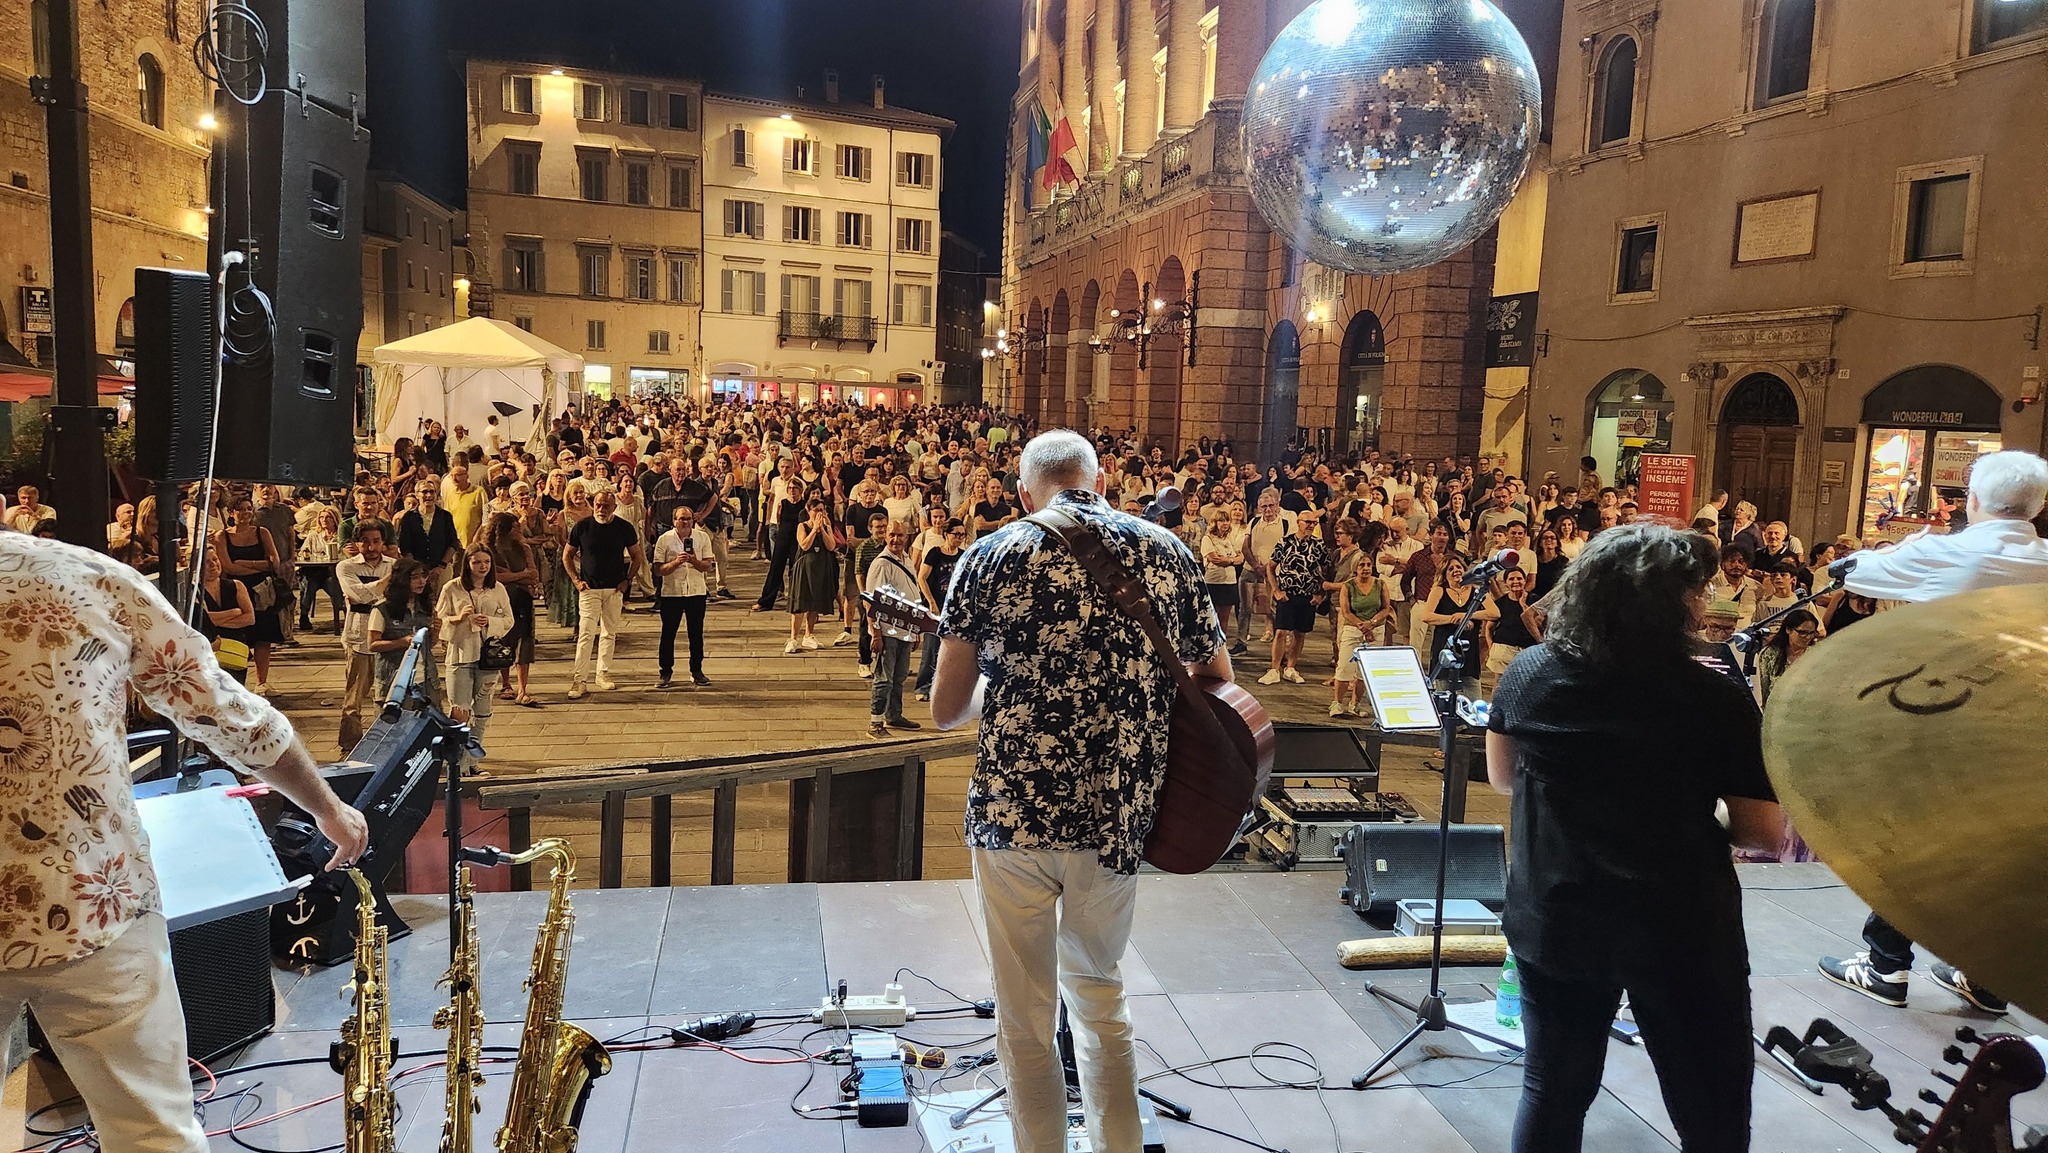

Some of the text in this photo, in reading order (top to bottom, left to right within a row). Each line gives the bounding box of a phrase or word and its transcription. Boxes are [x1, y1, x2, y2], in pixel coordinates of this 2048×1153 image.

[31, 290, 45, 303] T
[1840, 370, 1848, 378] 16
[1892, 411, 1938, 423] WONDERFUL
[1647, 457, 1688, 467] LE SFIDE
[1645, 474, 1687, 484] INSIEME
[1936, 468, 1960, 481] SCONTI
[1650, 490, 1680, 498] PERSONE
[1649, 497, 1680, 505] RICERCA
